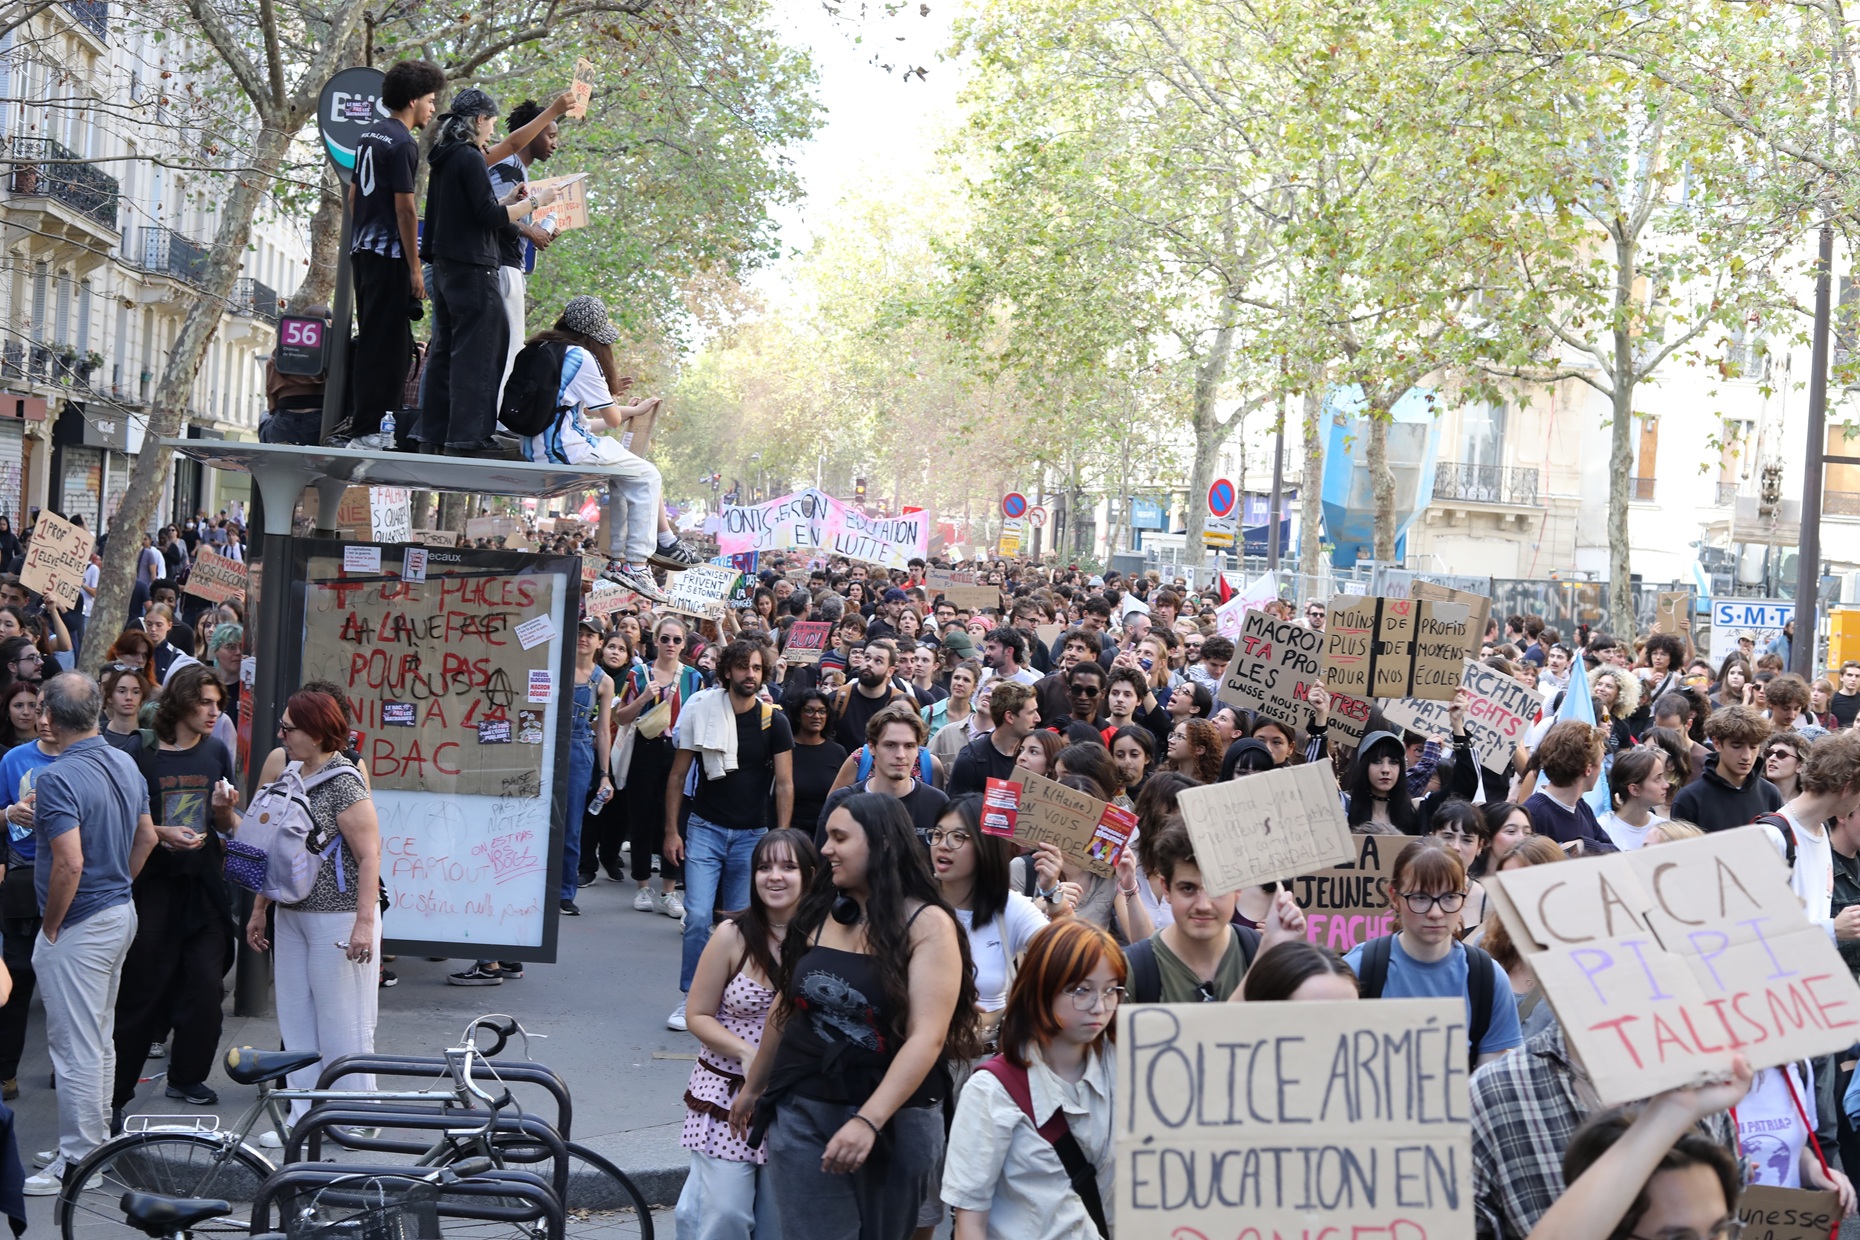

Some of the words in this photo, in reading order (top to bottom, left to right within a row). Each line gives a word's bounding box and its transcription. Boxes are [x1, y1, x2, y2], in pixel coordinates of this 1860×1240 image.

[287, 322, 317, 345] 56
[36, 518, 48, 540] 1
[46, 521, 68, 542] PROF
[70, 536, 89, 559] 35
[795, 525, 820, 547] EN
[835, 534, 891, 563] LUTTE
[27, 547, 39, 569] 1
[195, 562, 216, 577] NOS
[201, 552, 219, 565] ON
[428, 552, 461, 563] ecaux
[42, 572, 57, 595] 5
[56, 579, 80, 603] KEUFS
[190, 571, 212, 587] POUR
[379, 570, 421, 602] DE
[439, 569, 538, 613] PLACES
[672, 582, 685, 592] ET
[683, 573, 724, 590] PRIVENT
[444, 610, 507, 646] FAC
[1386, 617, 1408, 630] DE
[1243, 636, 1273, 662] TA
[1281, 649, 1321, 677] PRO
[1329, 634, 1366, 656] PLUS
[1384, 641, 1406, 655] DE
[1417, 642, 1464, 660] MOYENS
[348, 649, 428, 690] POUR
[441, 651, 492, 694] PAS
[1327, 666, 1365, 686] POUR
[1377, 668, 1403, 685] NOS
[1415, 664, 1461, 687] ÉCOLES
[1236, 659, 1280, 690] LES
[1293, 681, 1372, 722] NTRES
[1462, 663, 1542, 721] RCHING
[1270, 694, 1300, 714] NOUS
[371, 738, 462, 779] BAC
[502, 770, 536, 790] BAISE
[1022, 776, 1038, 794] LE
[500, 790, 514, 802] TA
[492, 802, 516, 815] PAS
[1018, 802, 1036, 814] ON
[1044, 808, 1081, 831] VOUS
[1192, 799, 1218, 825] On
[1223, 800, 1258, 816] sera
[487, 808, 544, 834] NOTES
[471, 843, 487, 856] ON
[491, 836, 514, 848] EST
[515, 831, 535, 843] PAS
[1587, 974, 1860, 1070] TALISME
[1128, 1007, 1312, 1133] POLICE
[1319, 1016, 1470, 1124] ARMÉE
[1748, 1117, 1792, 1133] PATRIA?
[1132, 1135, 1378, 1211] ÉDUCATION
[1395, 1144, 1460, 1211] EN
[1740, 1208, 1830, 1233] unesse
